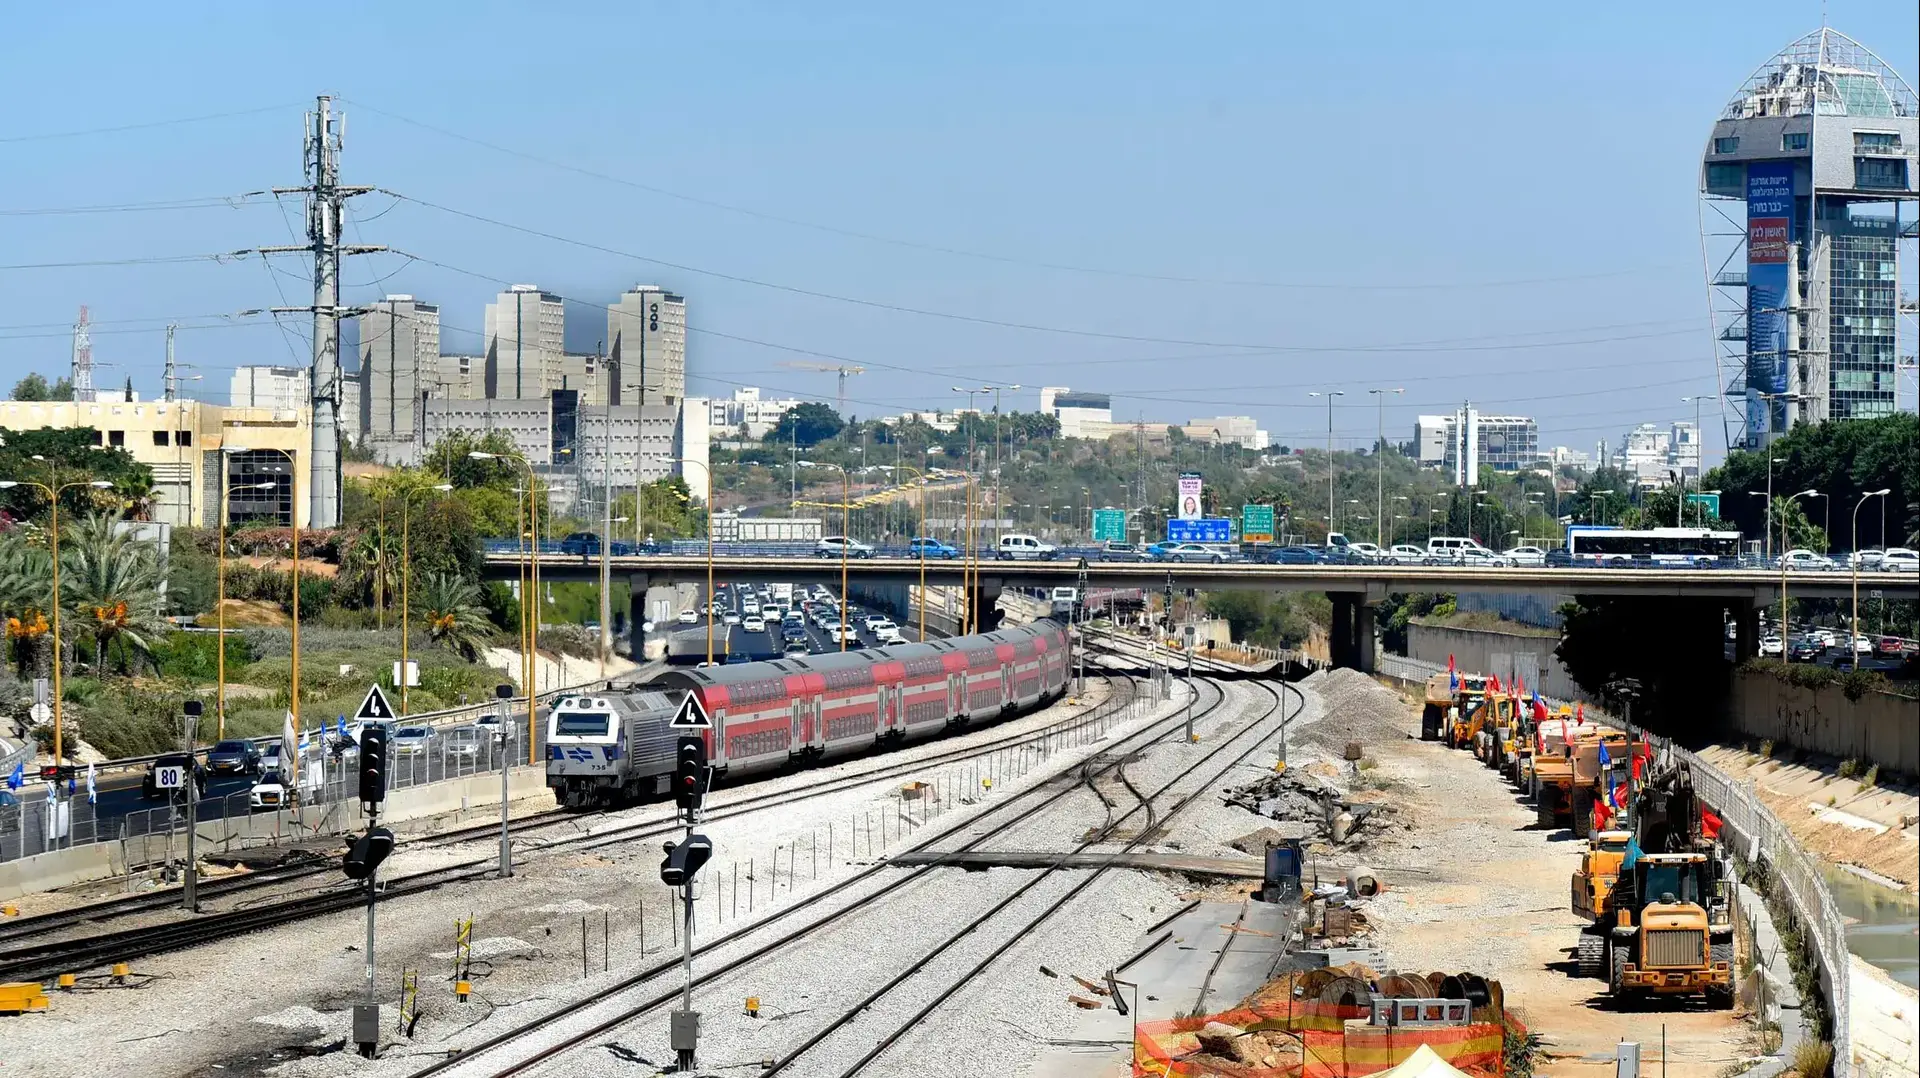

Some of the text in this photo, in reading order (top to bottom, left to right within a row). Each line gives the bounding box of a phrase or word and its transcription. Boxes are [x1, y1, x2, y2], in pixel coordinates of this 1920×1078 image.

[1765, 226, 1786, 240] ראשון
[370, 695, 381, 717] 4
[686, 702, 697, 723] 4
[161, 769, 177, 786] 80
